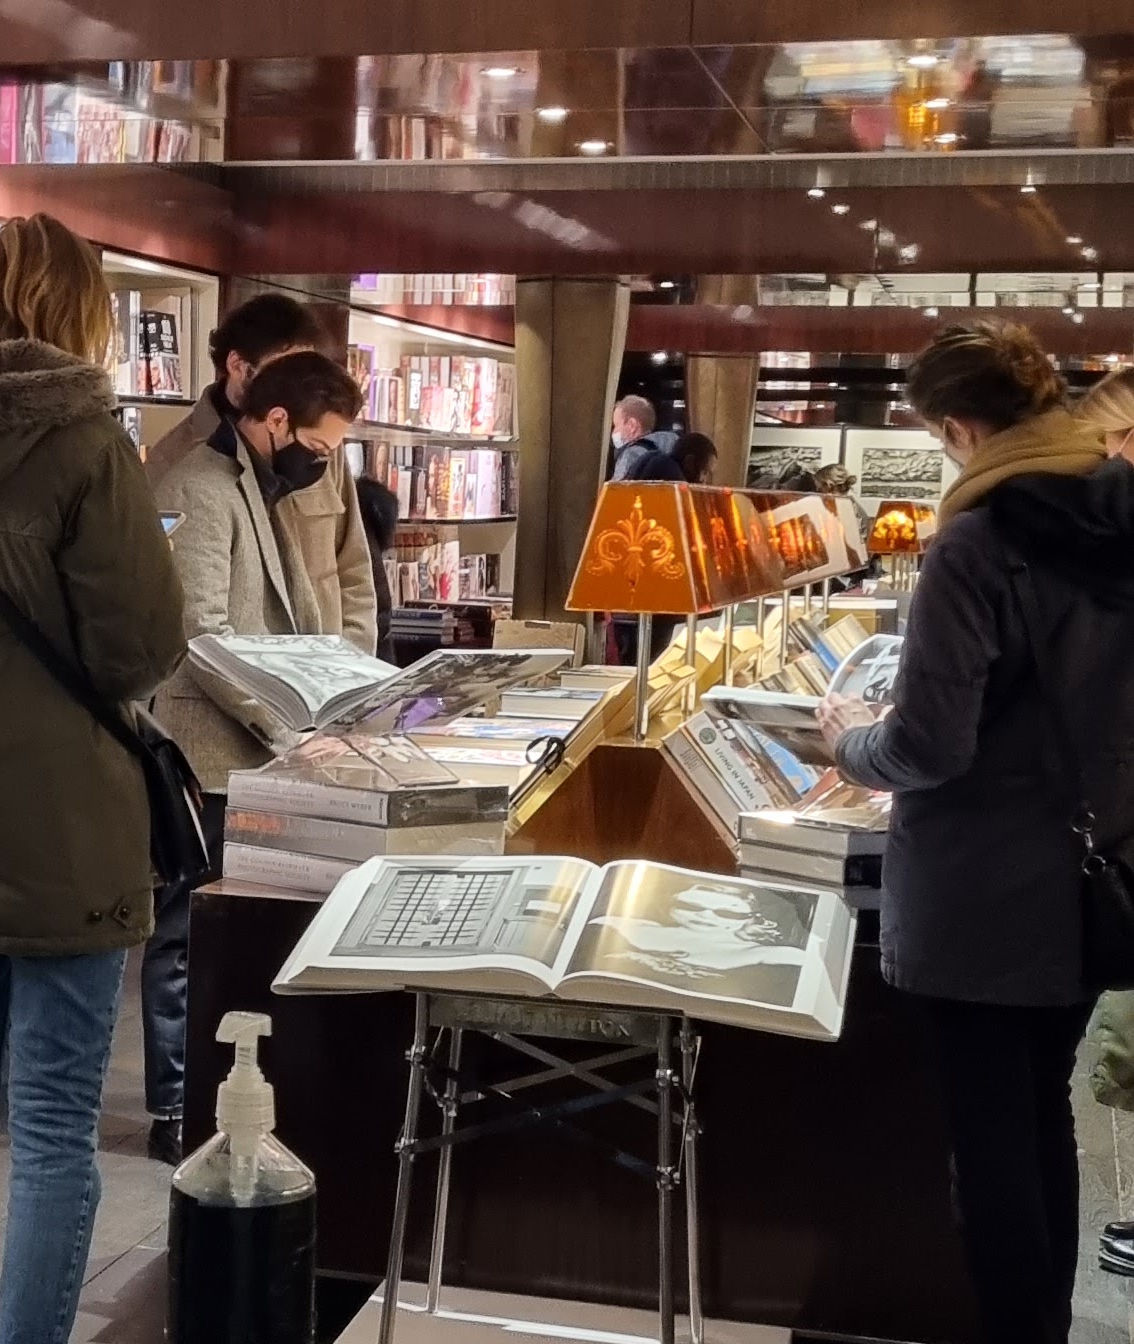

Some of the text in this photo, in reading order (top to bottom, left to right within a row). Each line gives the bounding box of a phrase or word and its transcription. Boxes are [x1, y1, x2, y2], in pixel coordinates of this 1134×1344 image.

[715, 748, 756, 801] LIVING IN JAPAN
